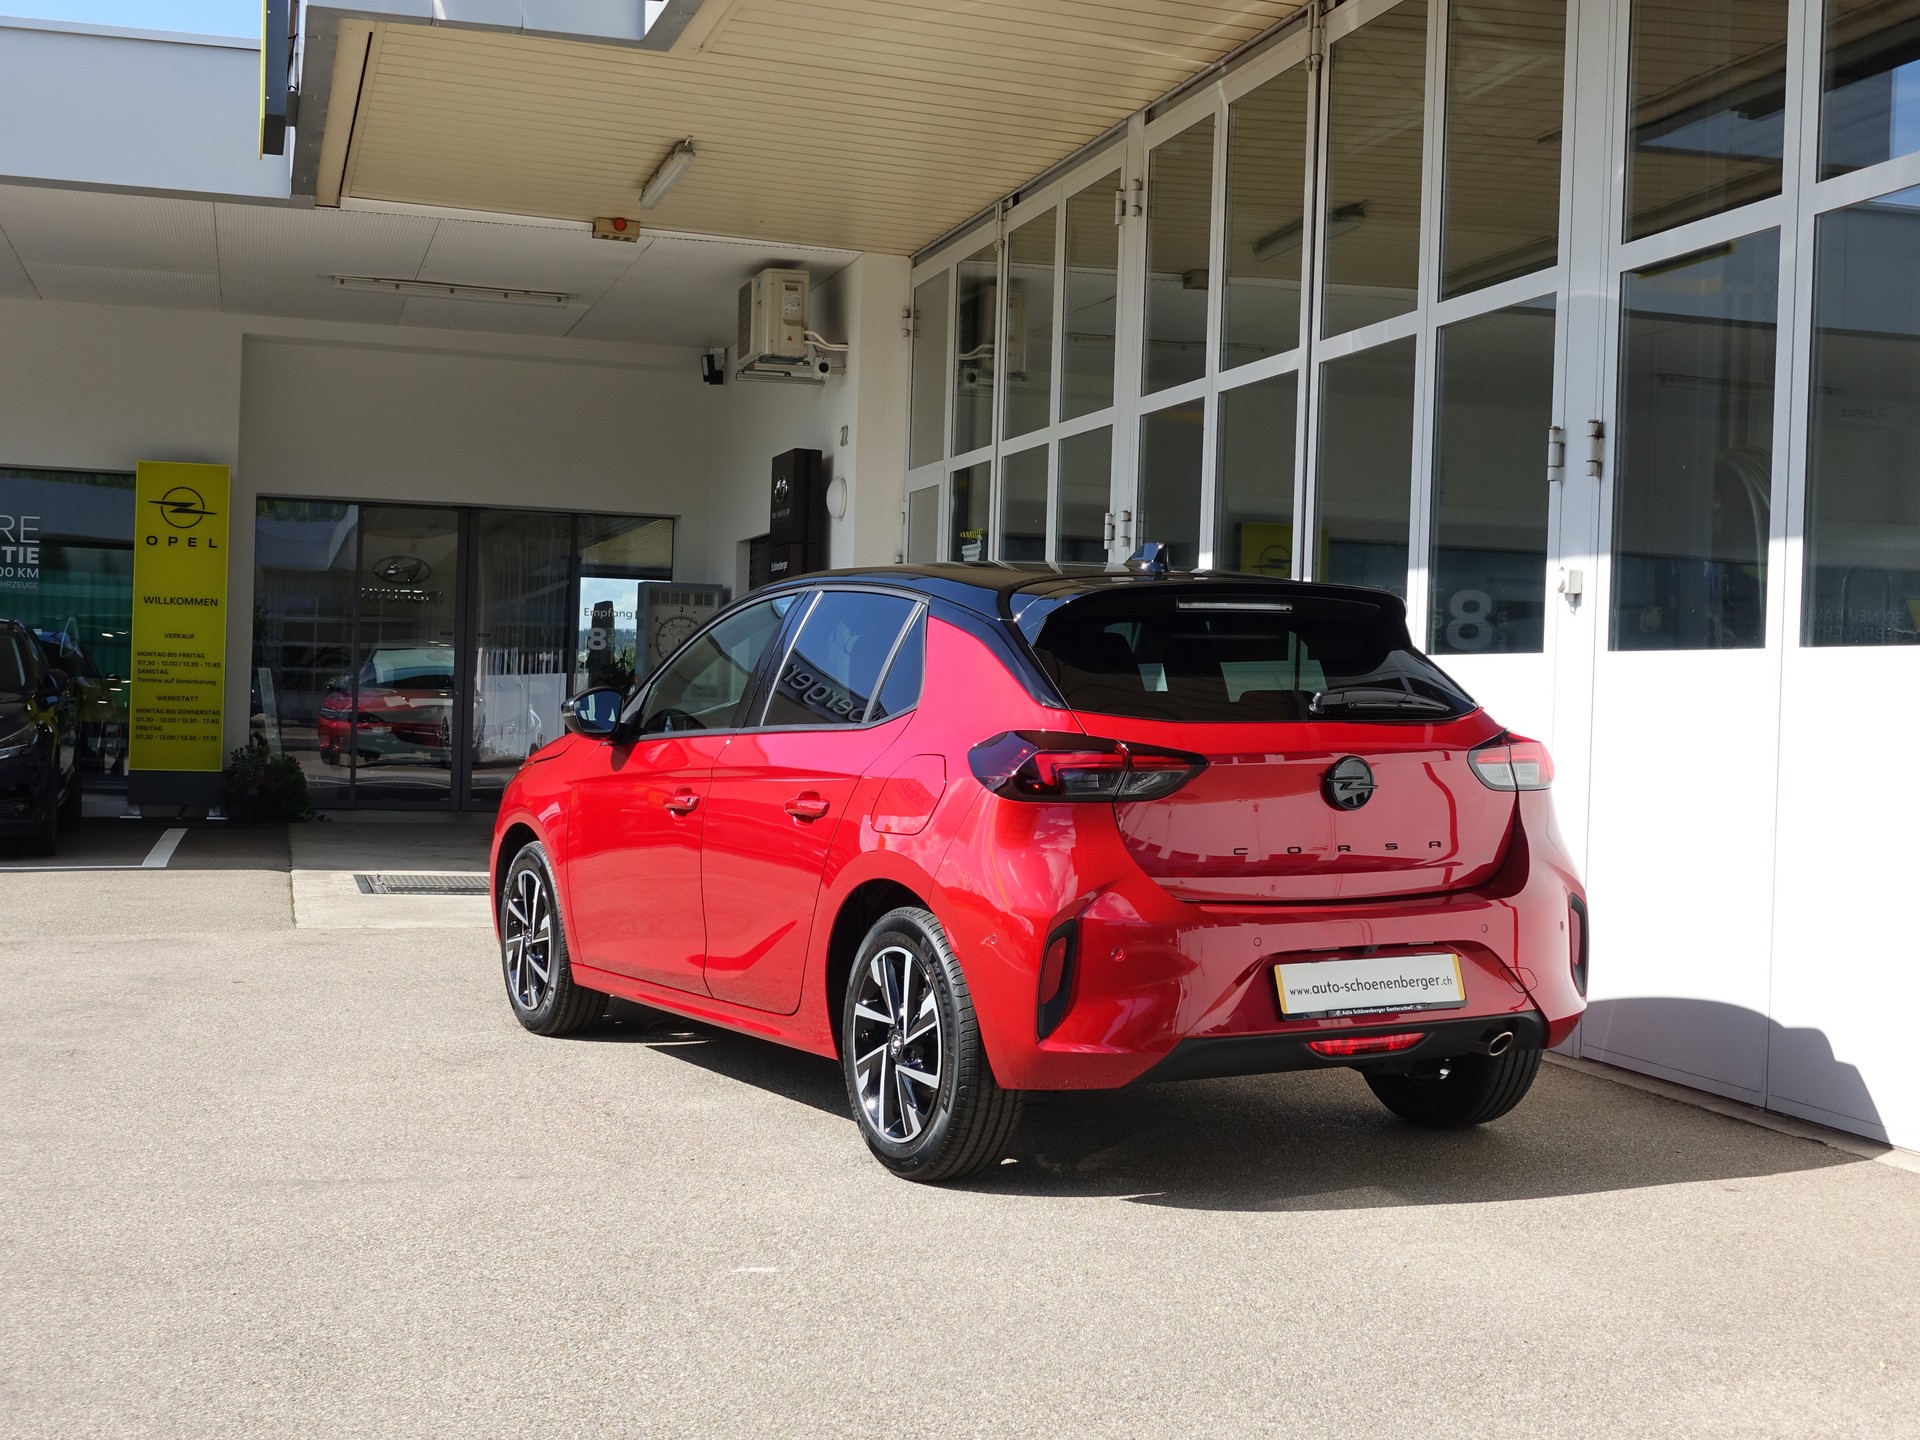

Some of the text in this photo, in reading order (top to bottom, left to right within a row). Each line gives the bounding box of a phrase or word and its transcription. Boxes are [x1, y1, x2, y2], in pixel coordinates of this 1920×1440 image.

[146, 535, 218, 548] OPEL
[1, 546, 40, 564] TIE
[17, 567, 39, 578] KM
[143, 596, 218, 607] WILLKOMMEN
[583, 607, 633, 620] Empfang
[587, 627, 608, 651] 8
[1233, 840, 1442, 856] CORSA
[1289, 975, 1453, 996] www.auto-schoenenberger.ch
[1353, 1007, 1386, 1015] Schönenberger
